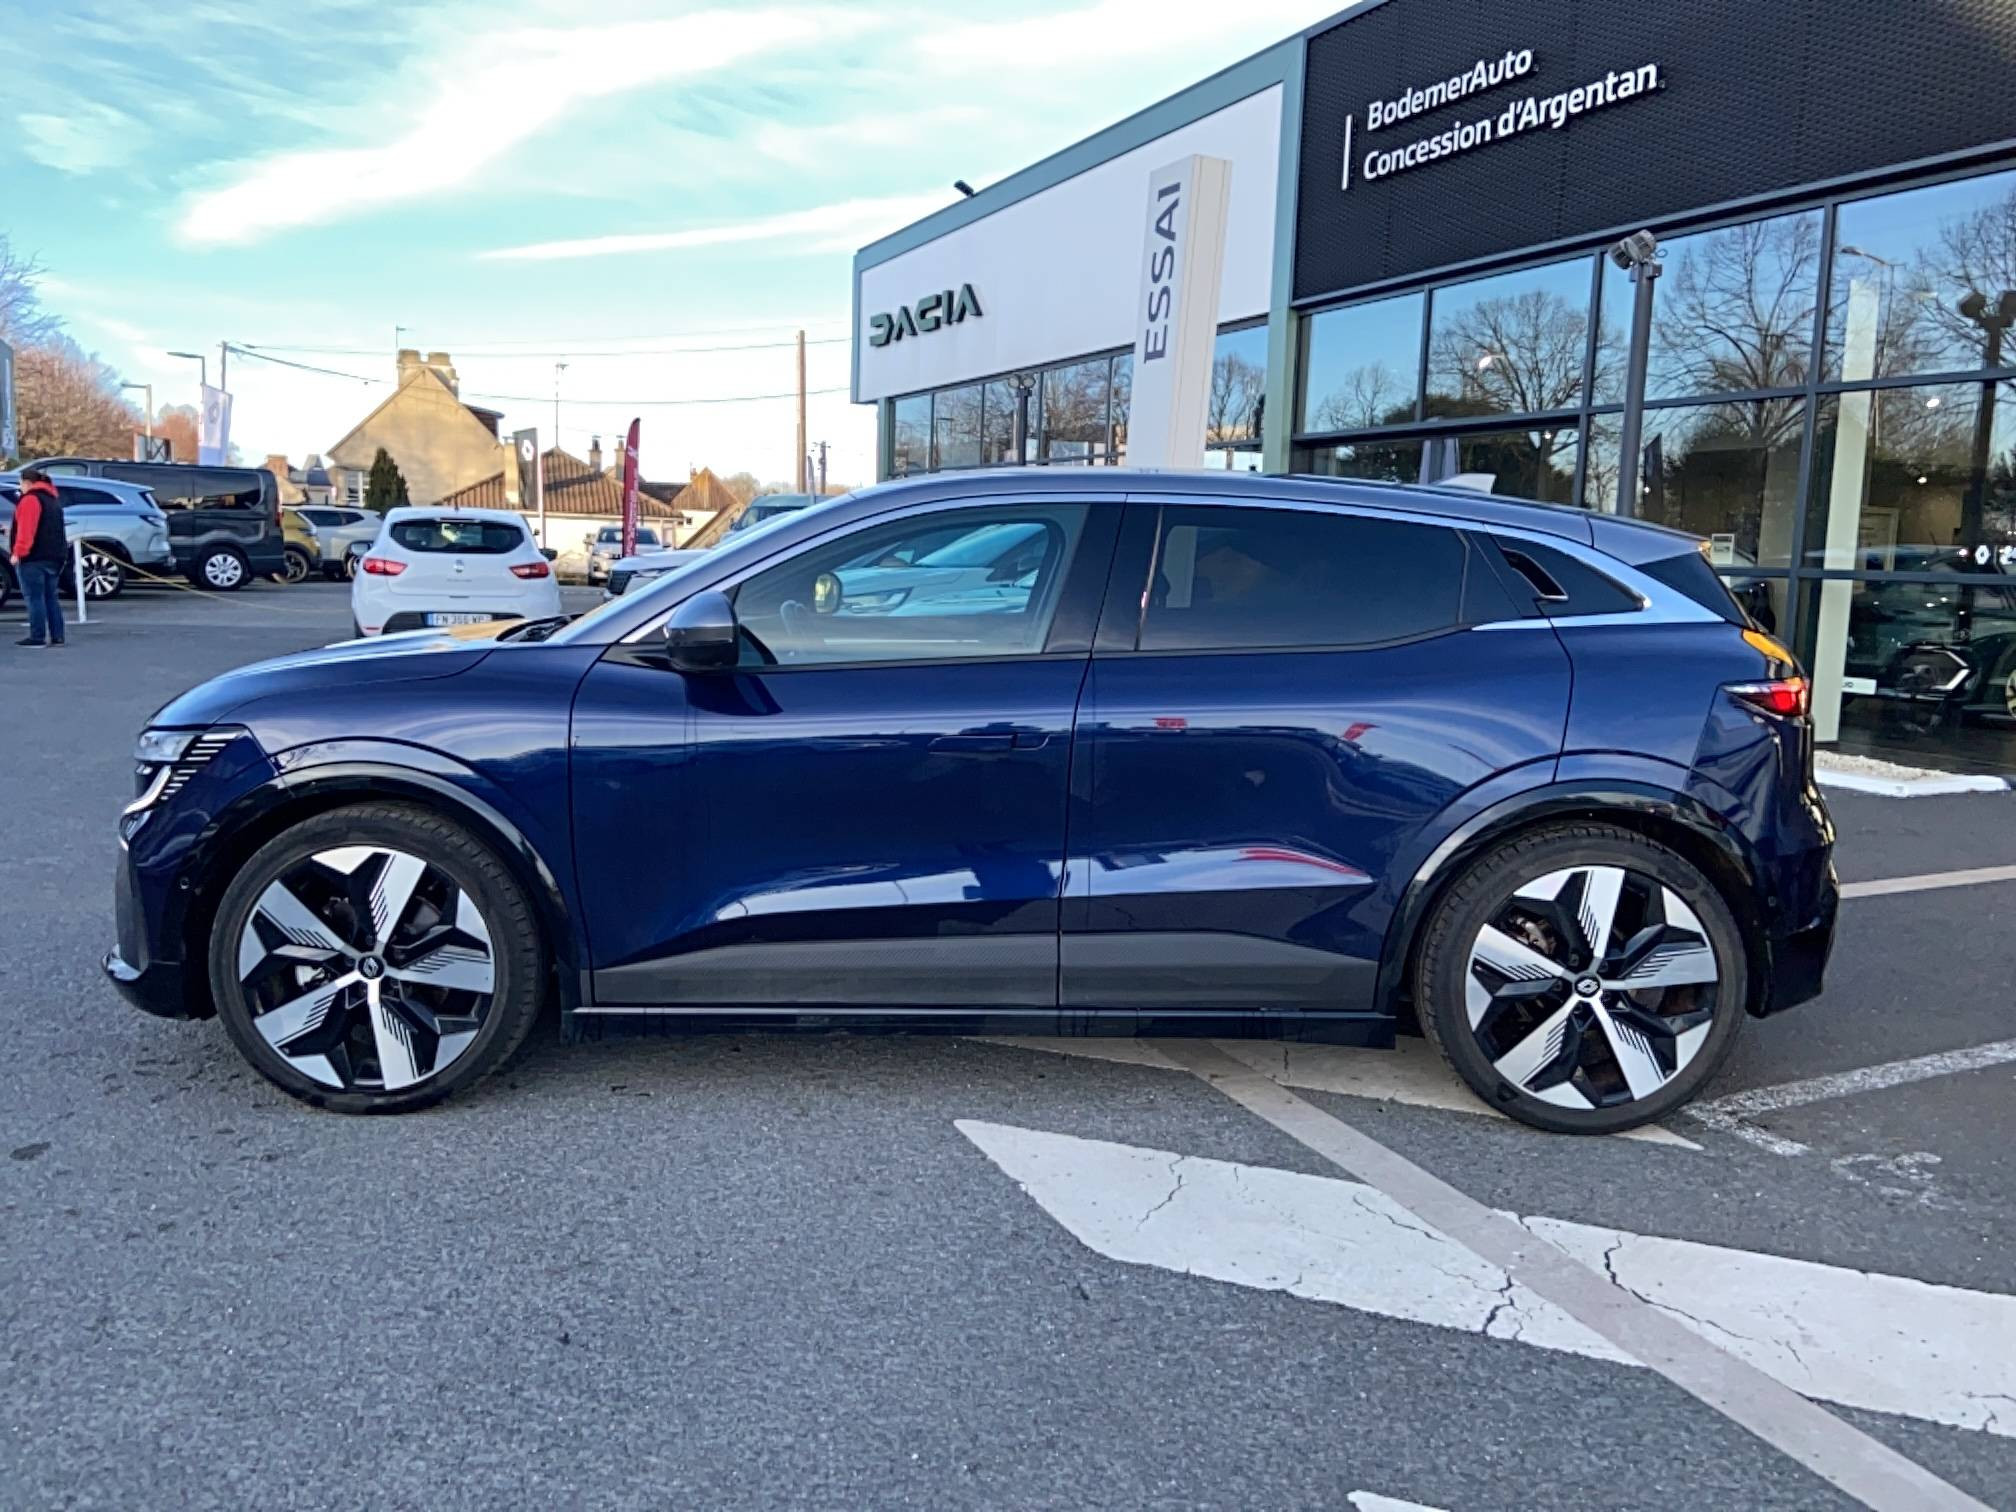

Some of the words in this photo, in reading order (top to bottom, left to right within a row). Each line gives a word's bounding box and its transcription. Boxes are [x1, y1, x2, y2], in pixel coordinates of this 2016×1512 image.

[1363, 120, 1492, 180] Concession
[1497, 62, 1658, 138] d'Argentan
[1367, 48, 1533, 131] BodemerAuto
[869, 283, 984, 348] DACIA
[1144, 181, 1181, 365] ESSAI
